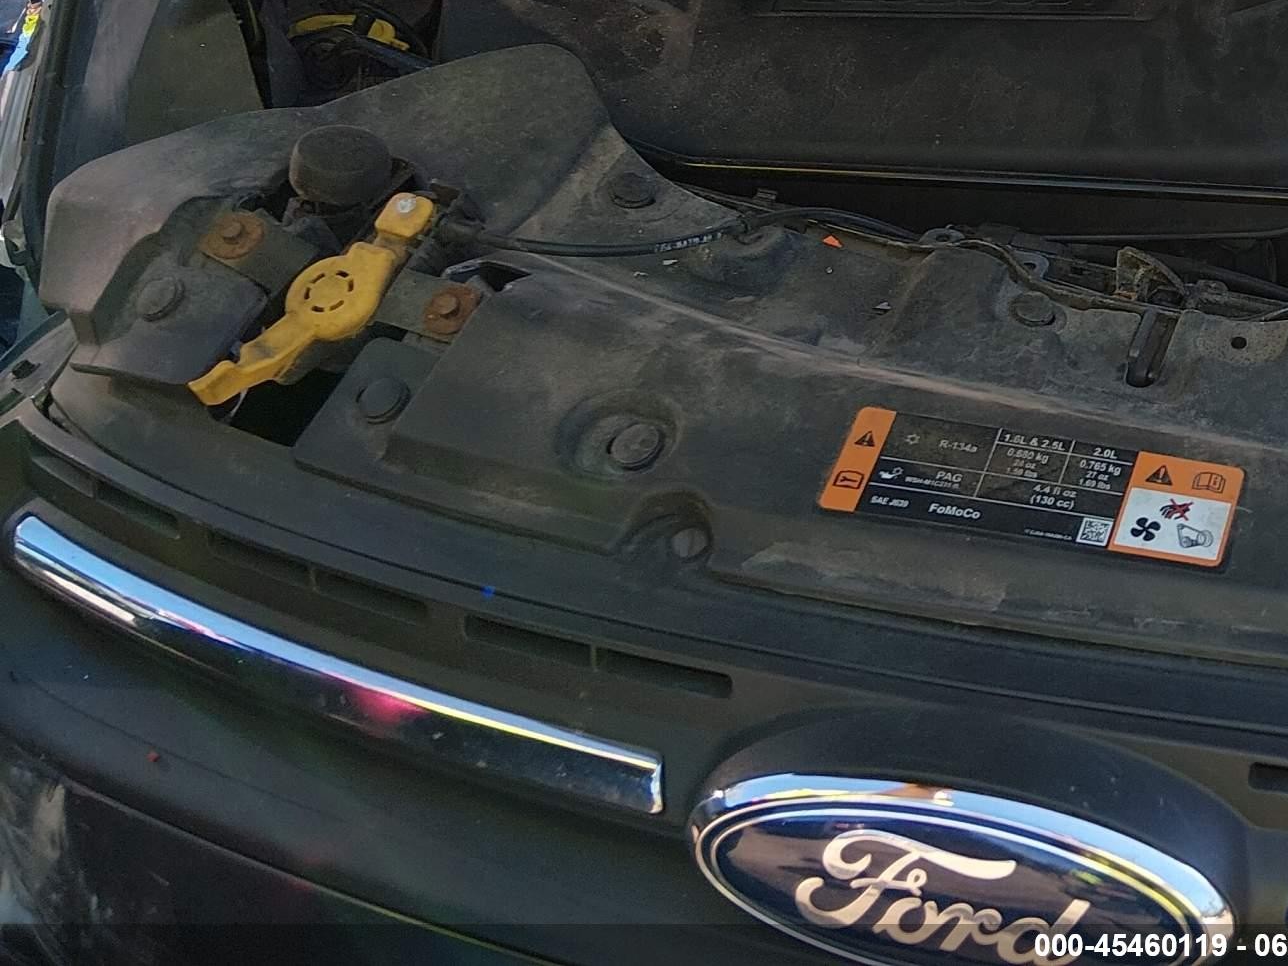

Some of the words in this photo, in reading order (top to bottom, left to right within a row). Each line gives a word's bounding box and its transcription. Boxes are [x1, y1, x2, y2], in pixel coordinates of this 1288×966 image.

[939, 439, 978, 453] R-134a
[1029, 437, 1039, 446] &
[1040, 439, 1065, 451] 2.5L
[1035, 452, 1050, 464] kg
[1094, 447, 1118, 459] 2.0L
[1080, 459, 1106, 471] 0.765
[1107, 463, 1121, 475] kg
[936, 471, 963, 483] PAG
[1084, 471, 1096, 479] 27
[1098, 482, 1111, 490] lbs
[870, 495, 889, 505] SAE
[1062, 490, 1077, 498] oz
[1030, 494, 1055, 505] (130
[1056, 498, 1075, 510] cc)
[928, 503, 981, 519] FoMoCo
[795, 829, 1092, 965] Ford
